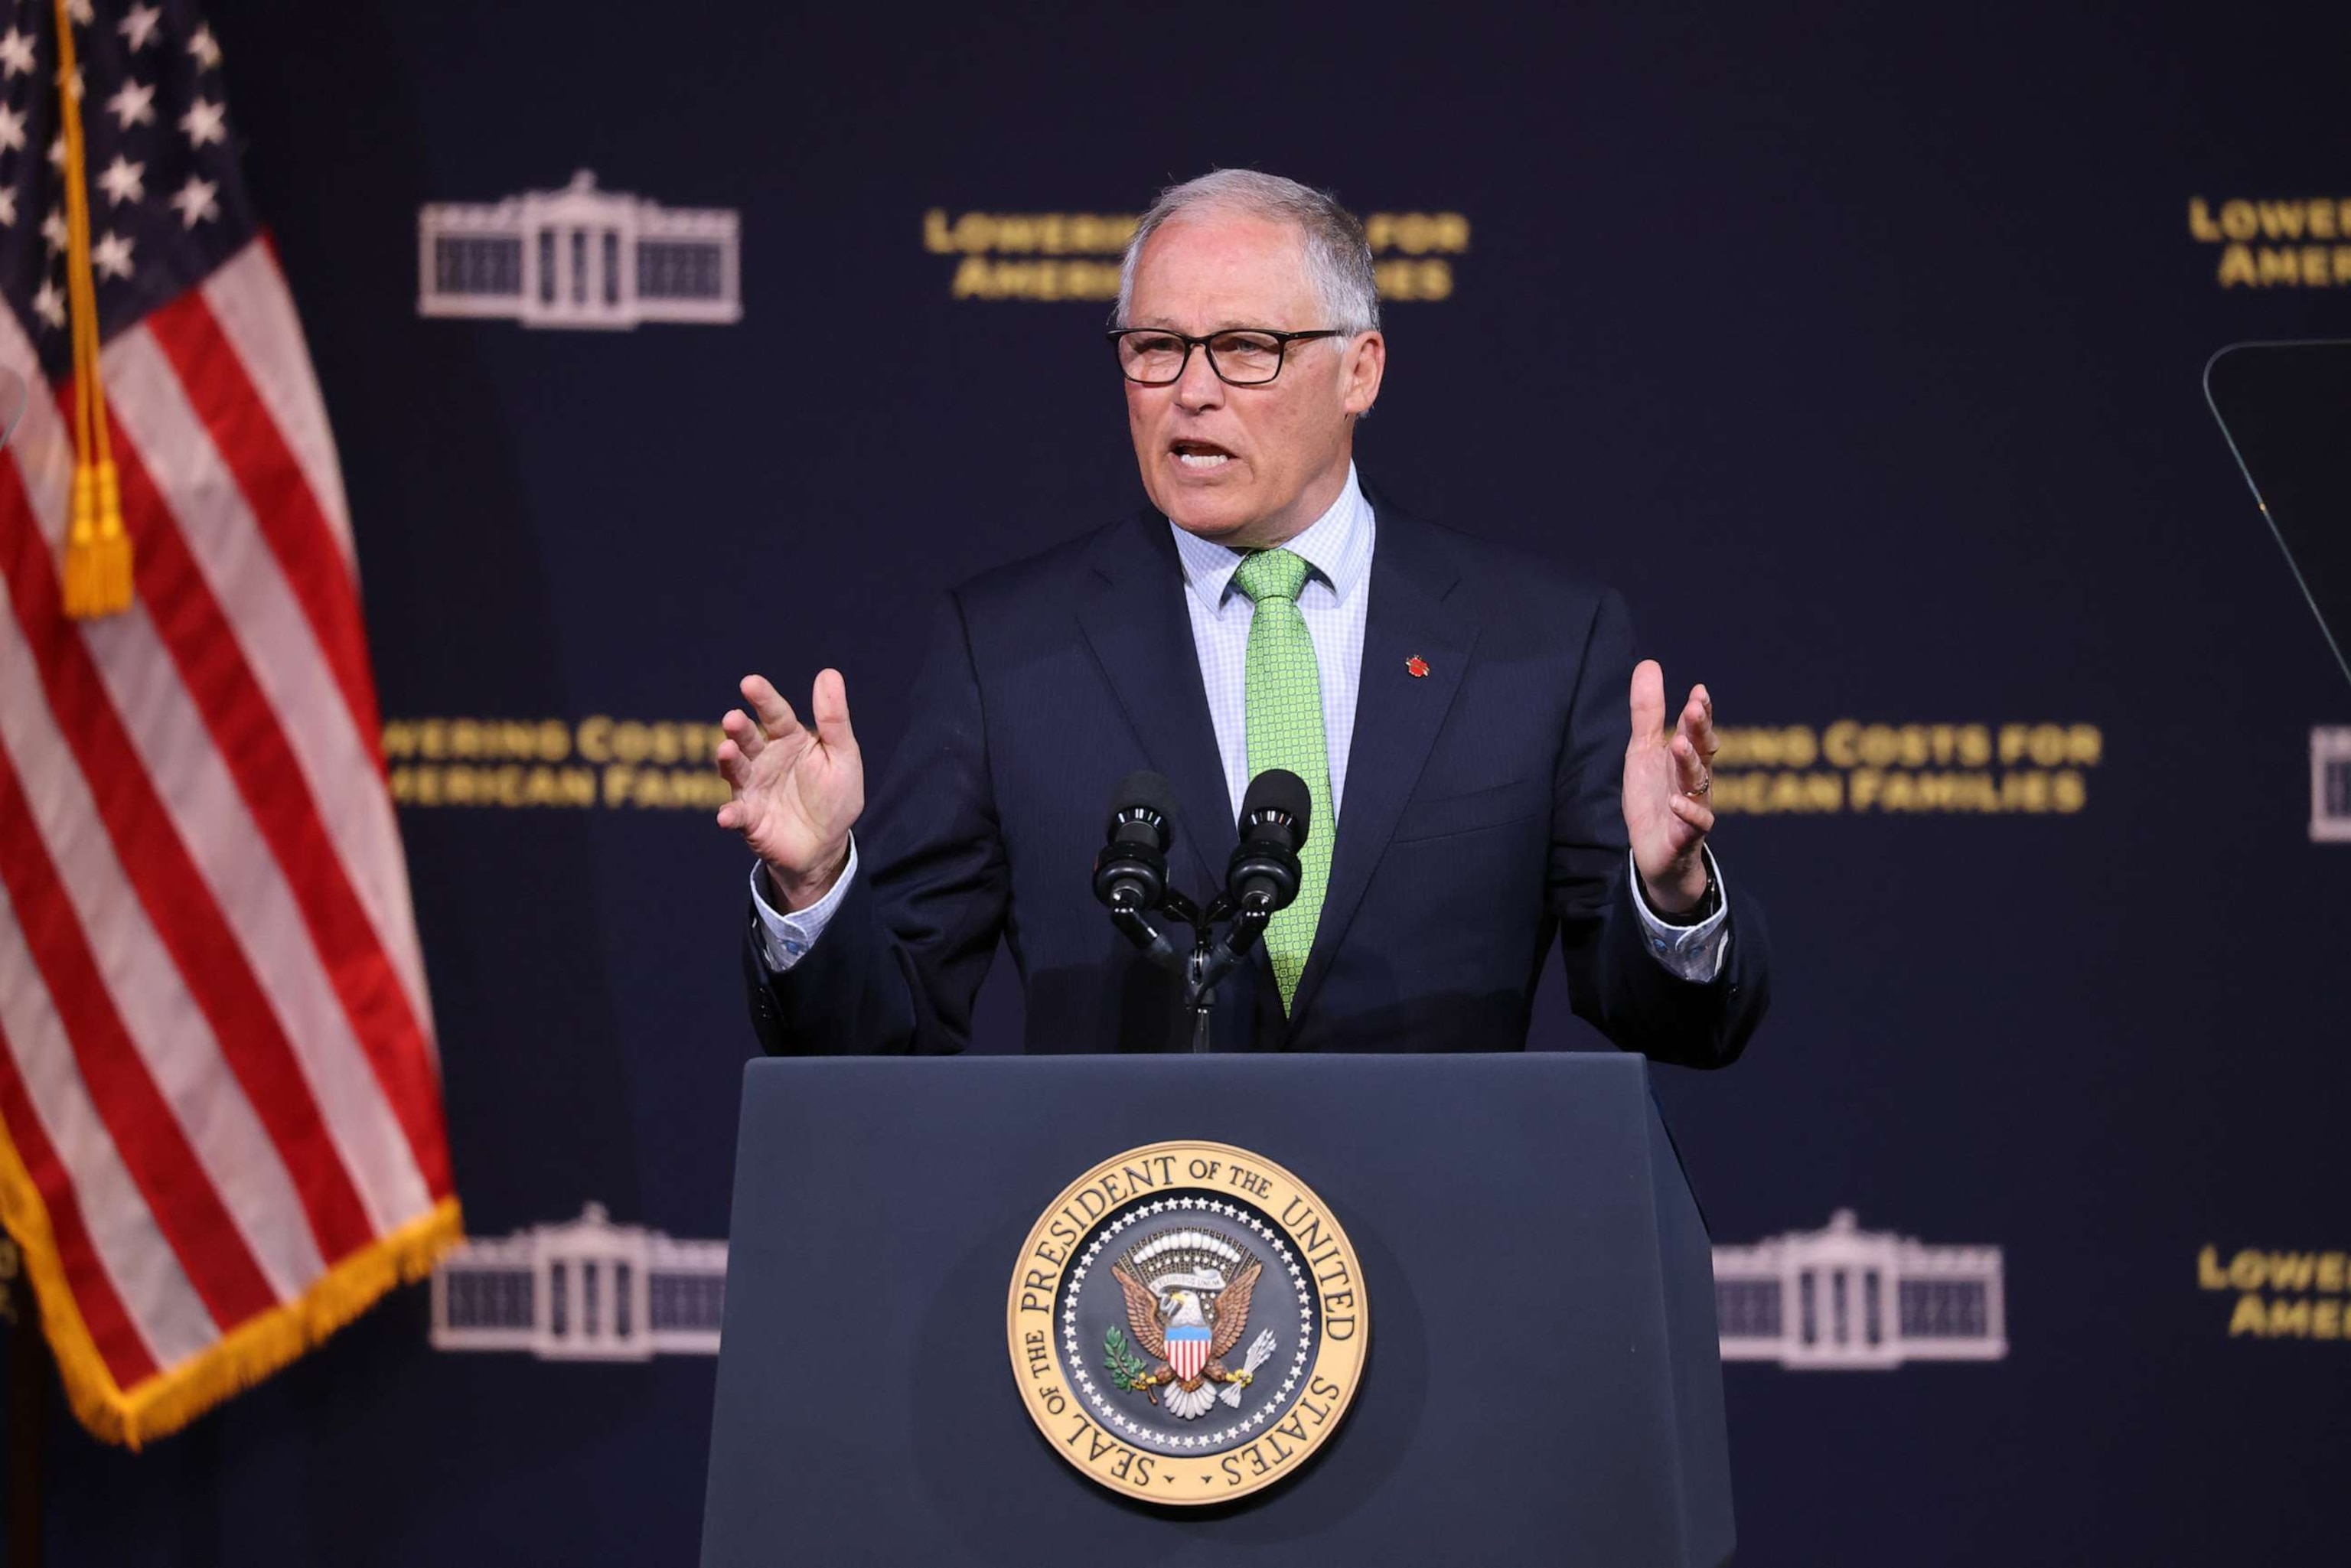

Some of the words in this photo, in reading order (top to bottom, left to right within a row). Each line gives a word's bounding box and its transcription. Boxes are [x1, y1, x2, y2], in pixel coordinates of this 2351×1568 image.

[1368, 212, 1470, 254] FOR
[1822, 719, 1991, 768] COSTS
[1998, 723, 2102, 767] FOR
[1849, 768, 2085, 814] FAMILIES
[1189, 1159, 1221, 1180] OF
[1229, 1165, 1273, 1201] THE
[1020, 1156, 1176, 1315] PRESIDENT
[1281, 1195, 1356, 1341] UNITED
[1025, 1329, 1051, 1379] THE
[1039, 1385, 1066, 1416] OF
[1066, 1413, 1156, 1487] SEAL
[1221, 1374, 1340, 1487] STATES
